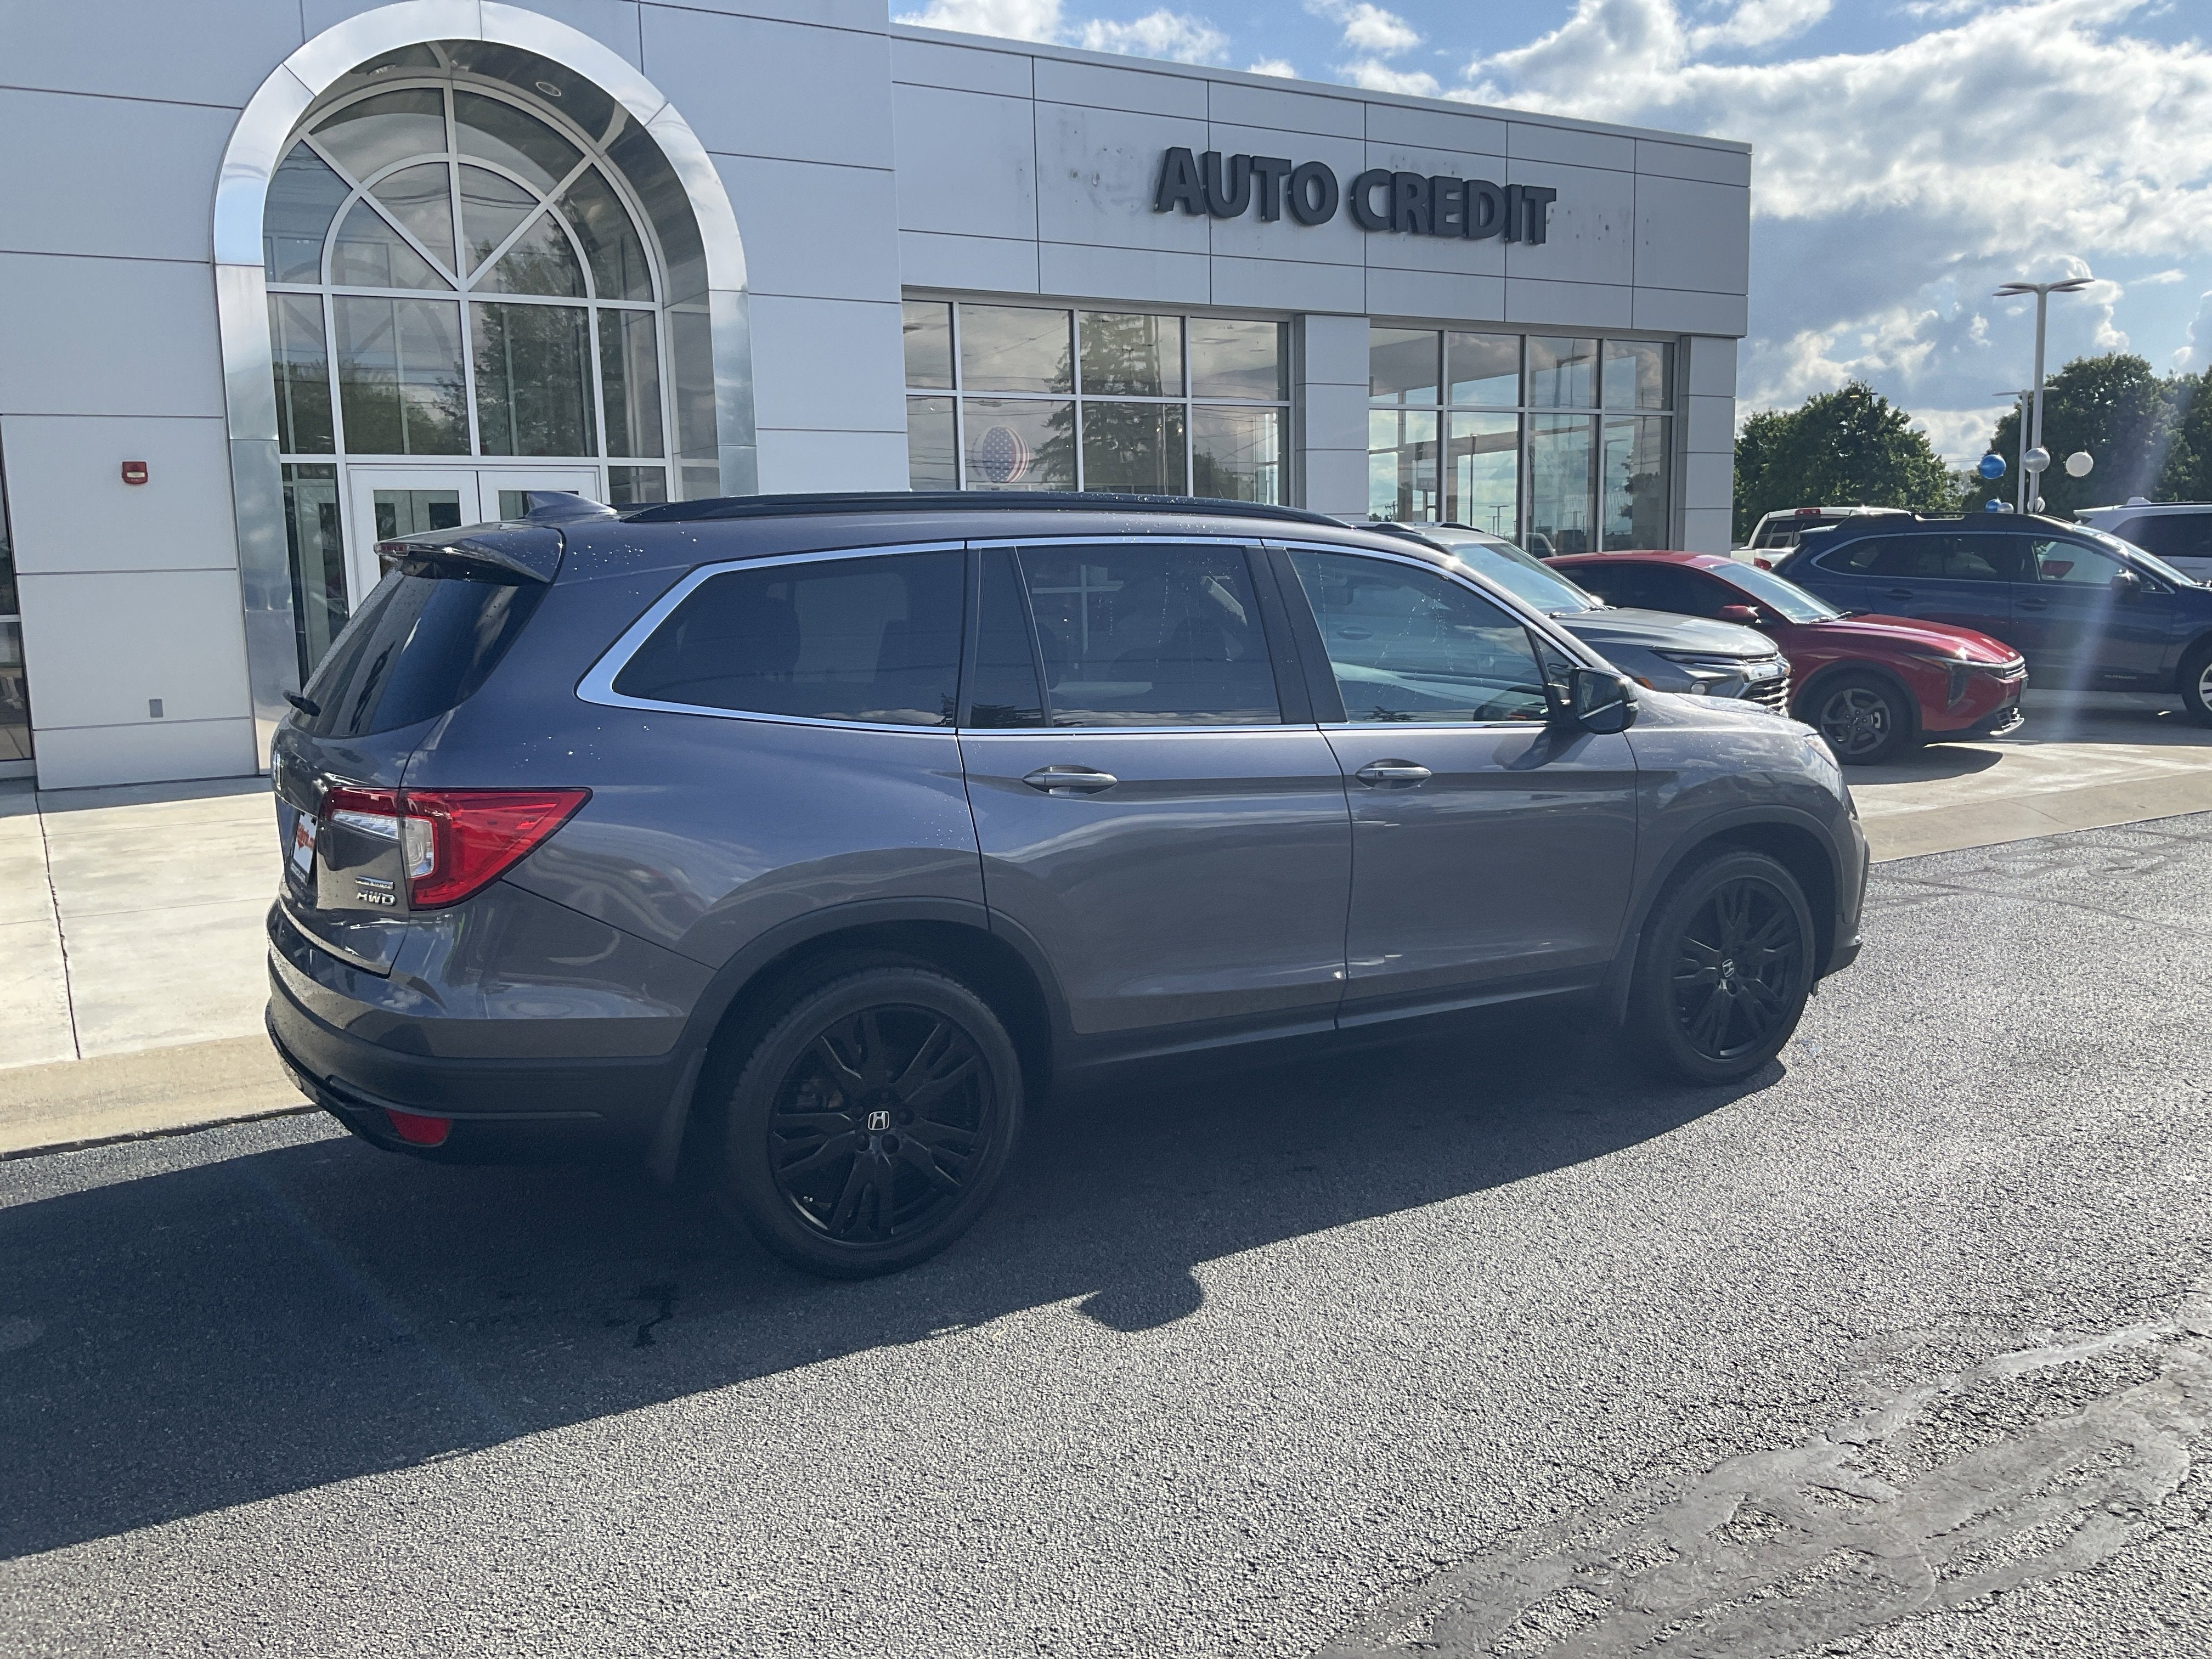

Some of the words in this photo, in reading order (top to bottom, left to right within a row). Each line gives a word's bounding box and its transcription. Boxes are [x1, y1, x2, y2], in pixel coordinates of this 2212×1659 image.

[1154, 146, 1339, 226] AUTO
[1350, 168, 1557, 244] CREDIT
[356, 890, 396, 906] AWD
